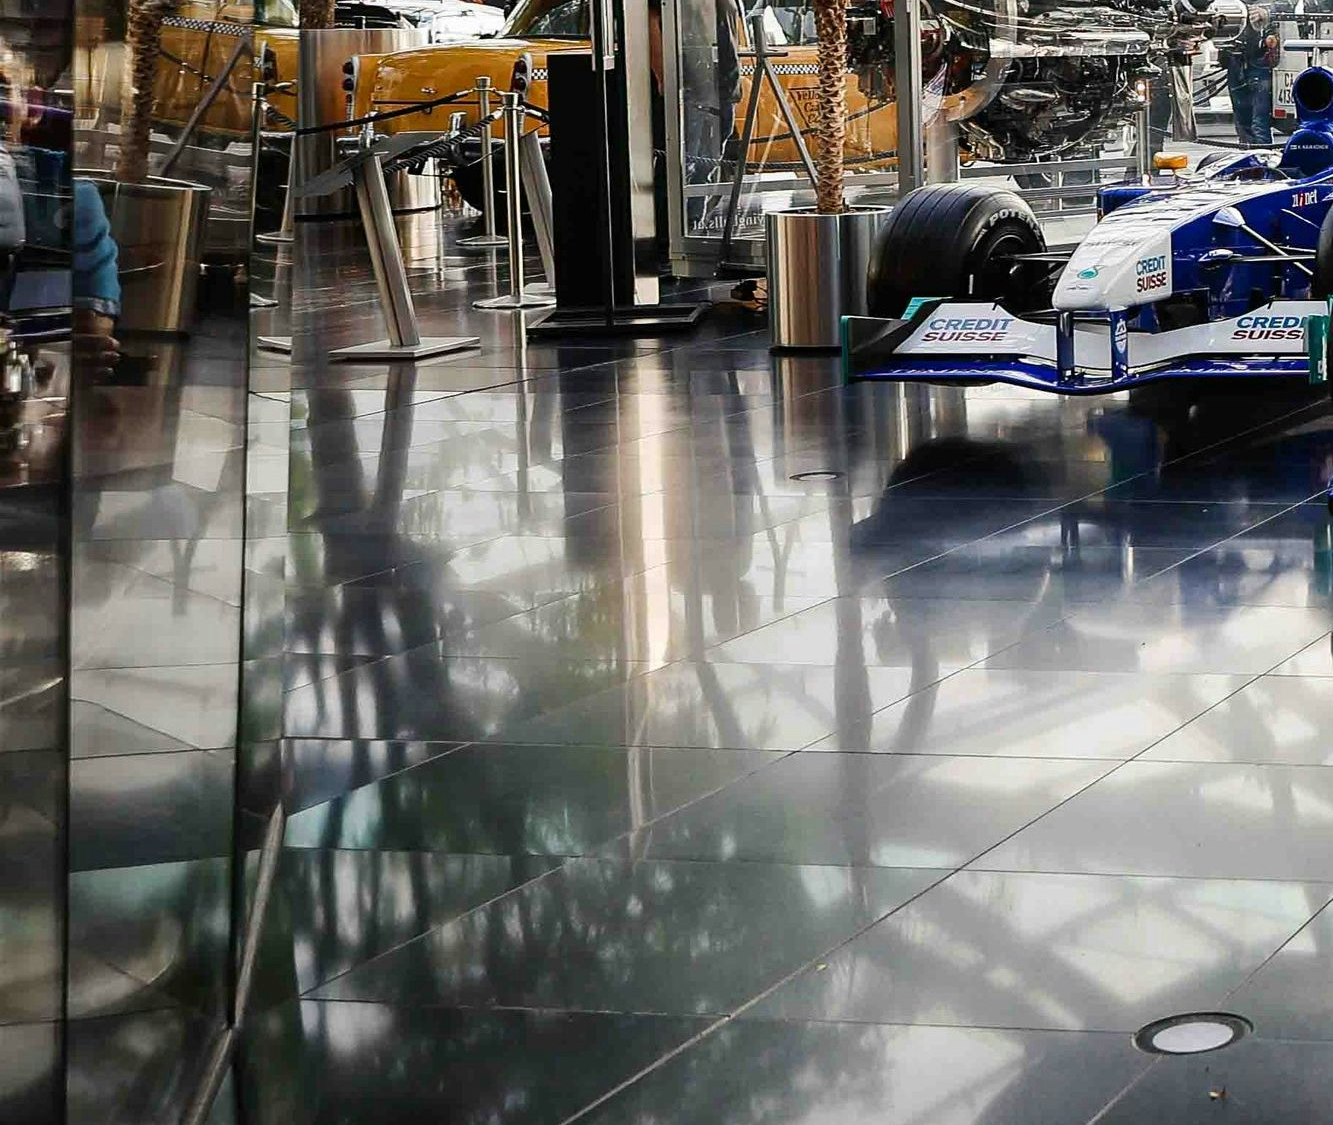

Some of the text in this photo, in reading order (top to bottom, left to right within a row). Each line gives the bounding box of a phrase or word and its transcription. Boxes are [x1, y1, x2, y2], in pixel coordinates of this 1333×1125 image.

[1136, 255, 1166, 276] CREDIT
[1137, 272, 1167, 293] SUISSE
[929, 318, 1014, 331] CREDIT
[922, 332, 1007, 342] SUISSE
